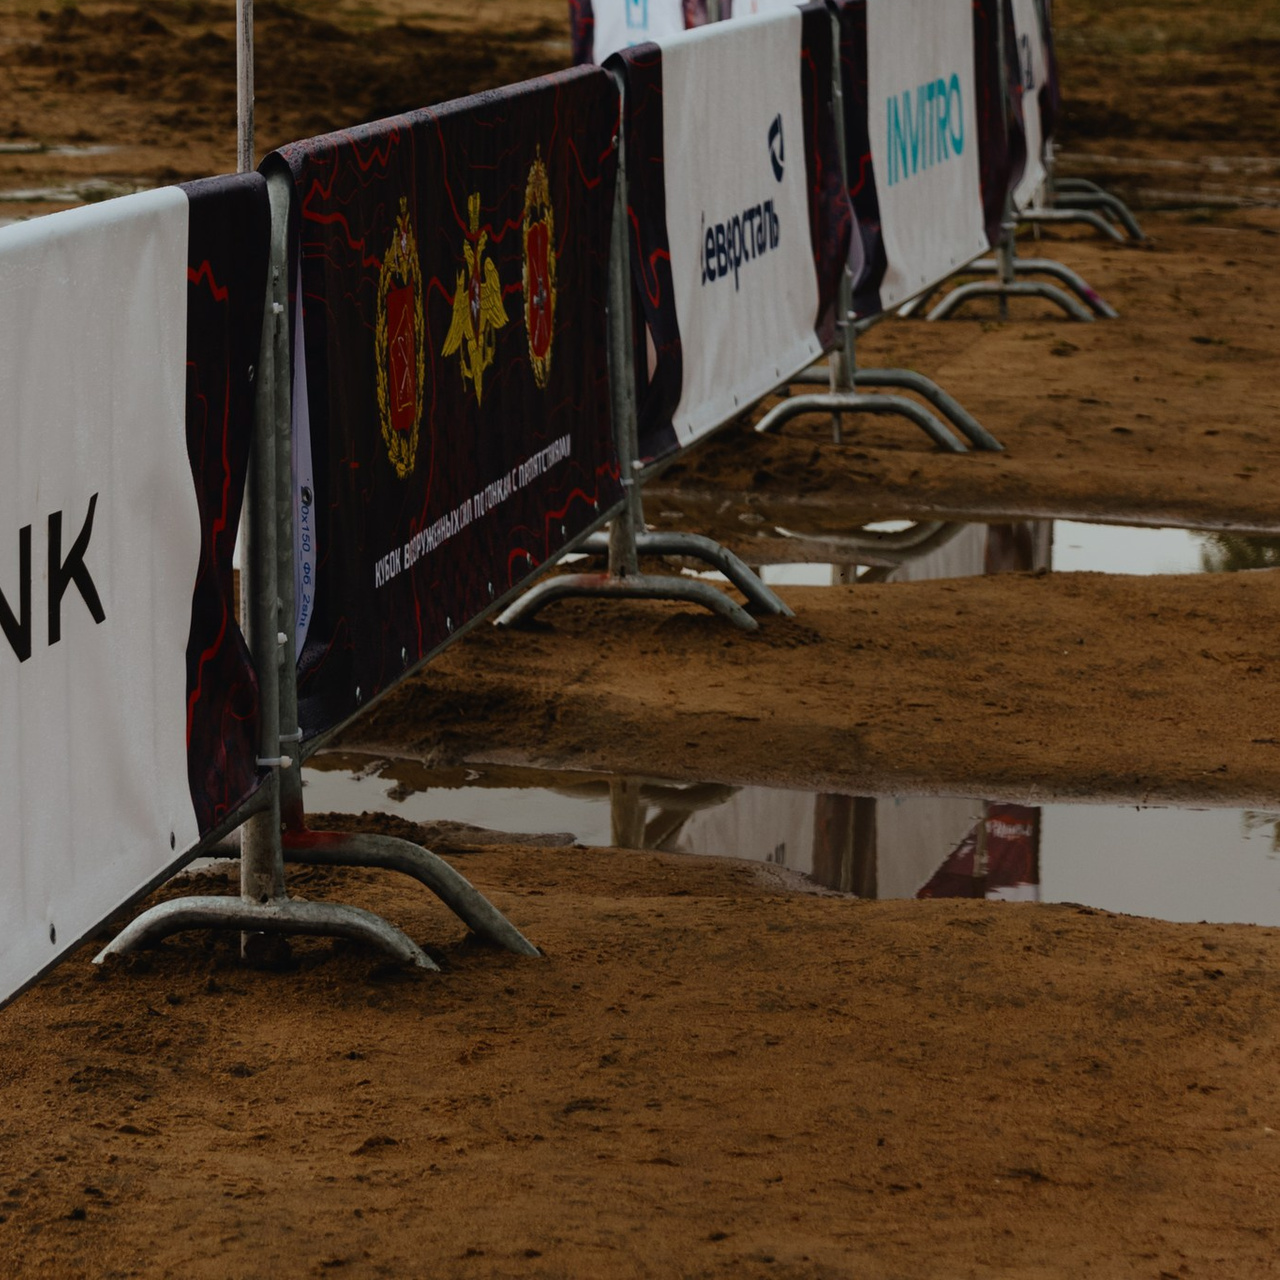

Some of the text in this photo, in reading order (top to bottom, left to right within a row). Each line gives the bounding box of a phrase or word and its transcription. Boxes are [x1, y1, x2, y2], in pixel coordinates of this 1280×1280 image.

[886, 70, 964, 187] INVITRO
[700, 198, 781, 292] еверсталь
[375, 547, 402, 589] КУБОК
